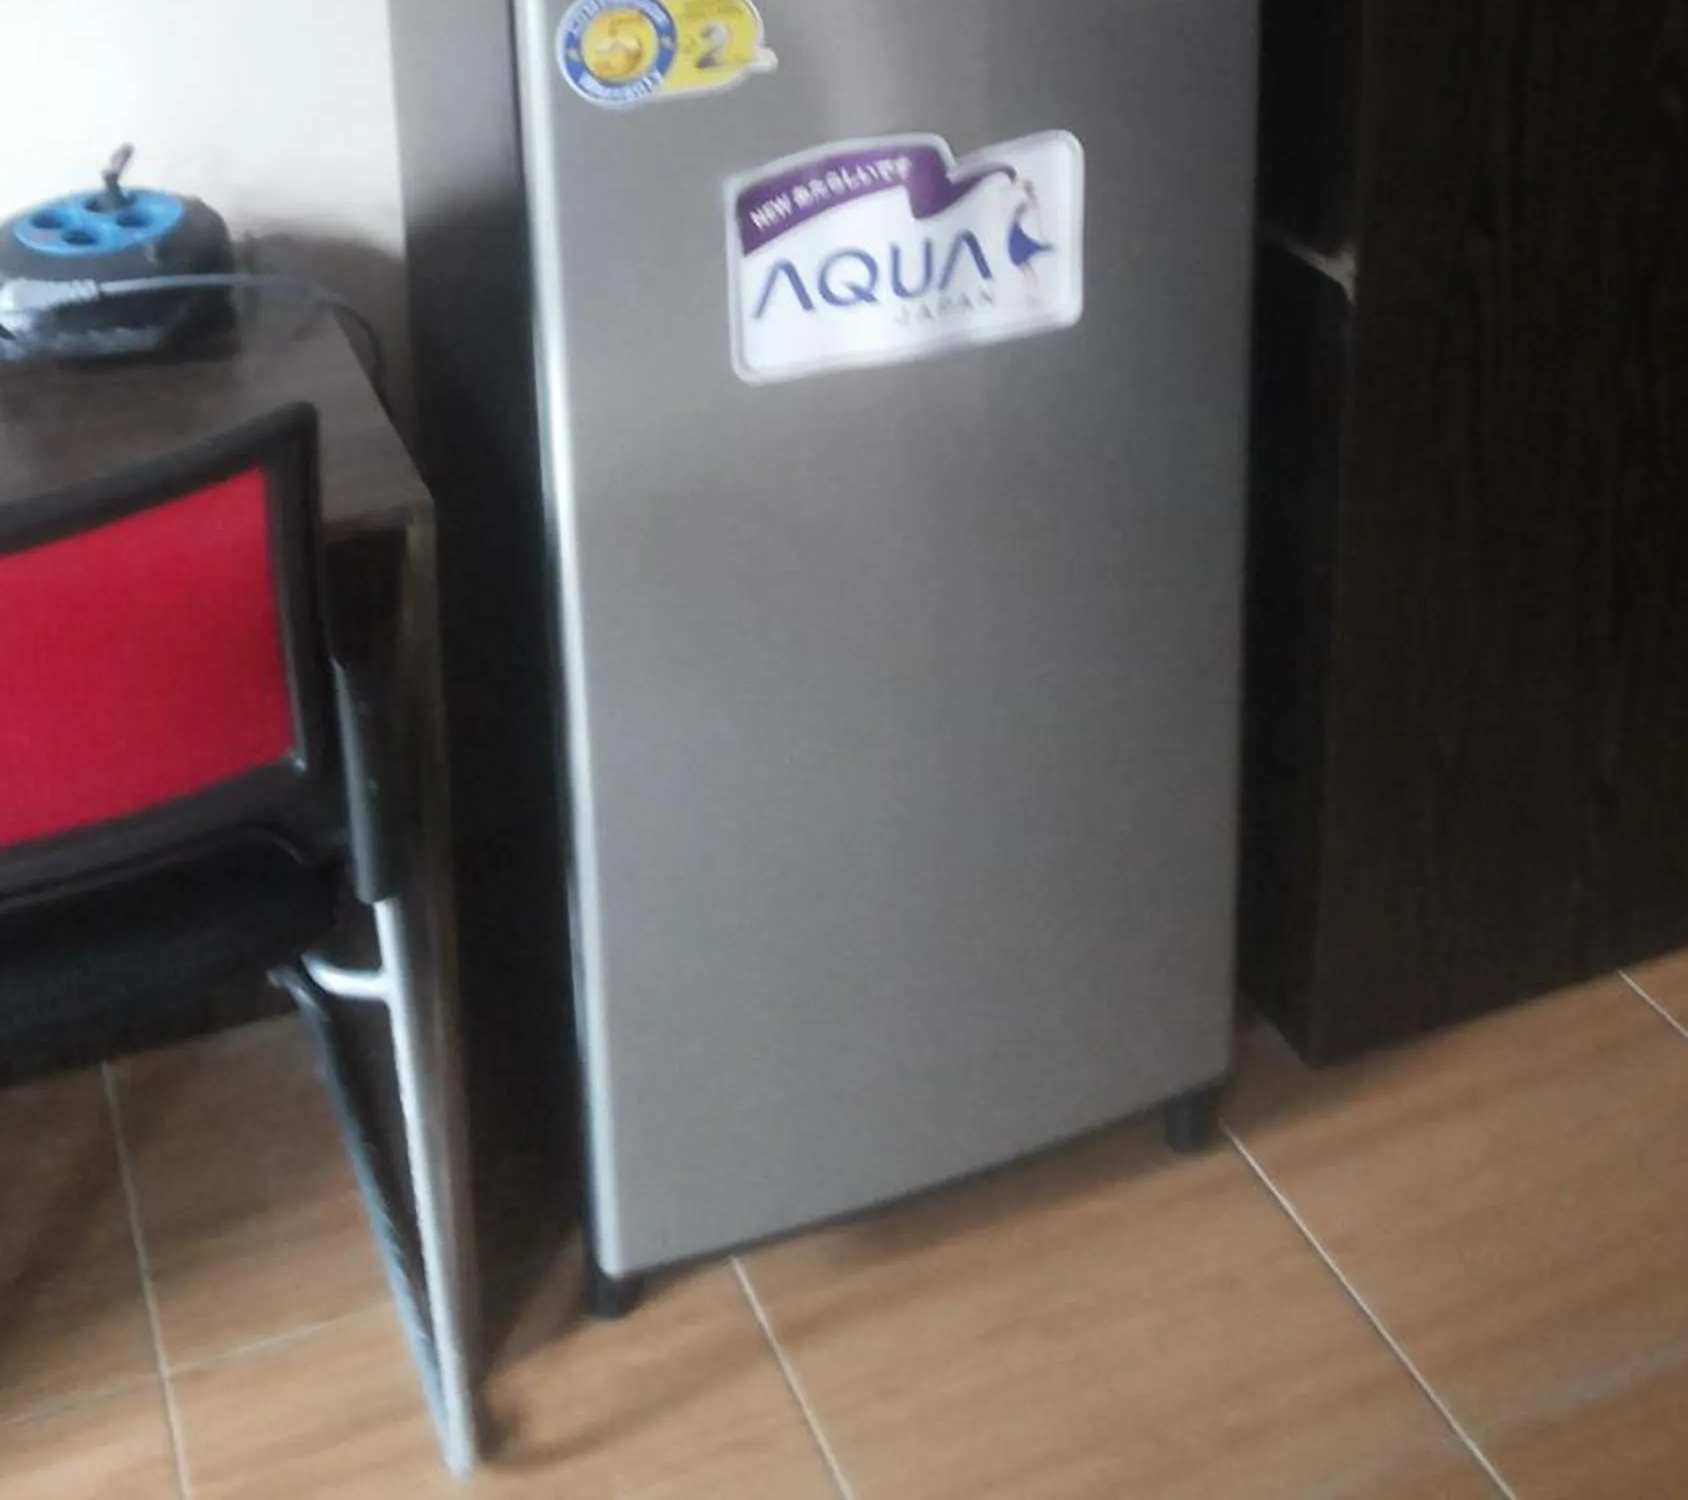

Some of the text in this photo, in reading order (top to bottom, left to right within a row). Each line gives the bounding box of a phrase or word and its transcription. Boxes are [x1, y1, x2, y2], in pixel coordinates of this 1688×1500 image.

[696, 19, 738, 70] 2
[749, 192, 792, 232] NEW
[752, 230, 993, 318] AQUA
[896, 287, 996, 325] JAPAN
